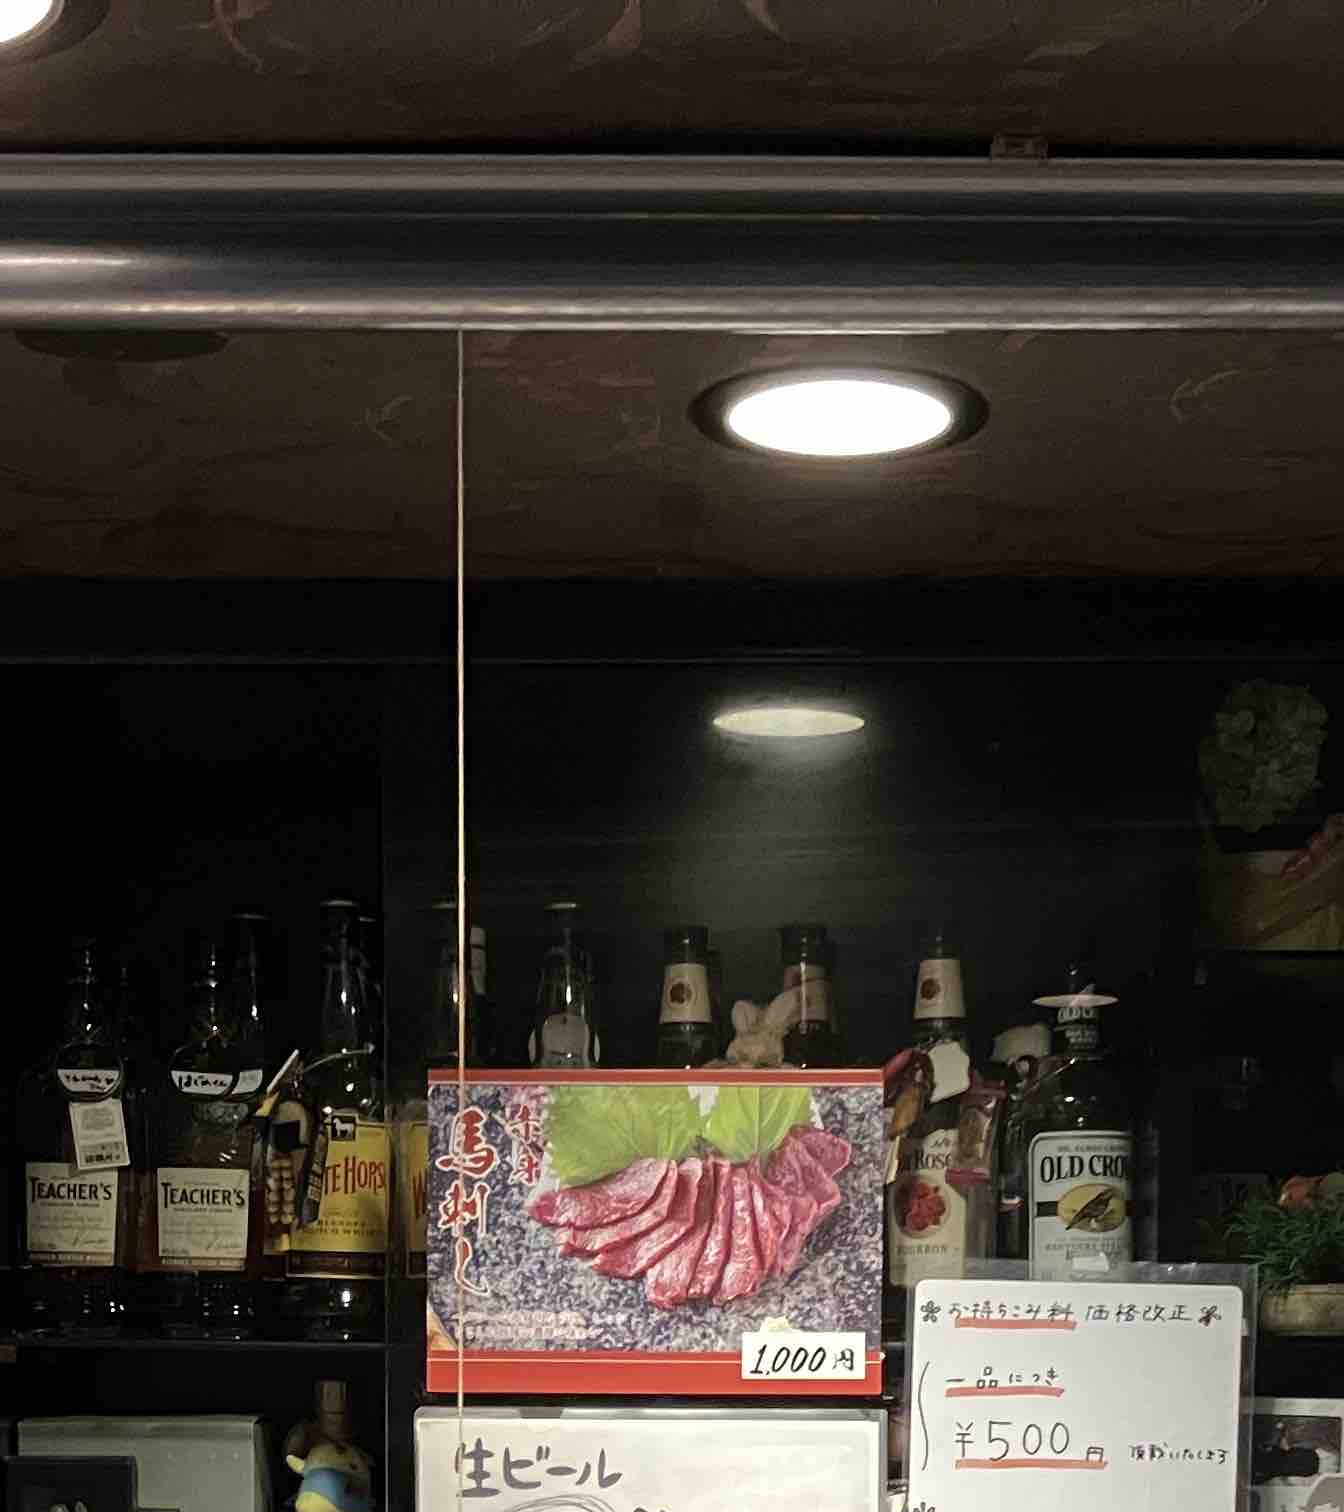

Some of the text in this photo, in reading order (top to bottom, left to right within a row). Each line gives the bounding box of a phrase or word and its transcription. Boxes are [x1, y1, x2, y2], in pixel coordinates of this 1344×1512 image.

[509, 1104, 542, 1186] 赤身
[1040, 1154, 1130, 1184] OLD CRO
[30, 1177, 113, 1204] TEACHER'S
[161, 1182, 246, 1209] TEACHER'S
[436, 1106, 498, 1297] 馬刺し
[1084, 1302, 1192, 1322] 価格改正
[749, 1345, 856, 1377] 1,000円
[455, 1437, 623, 1498] 生ビール
